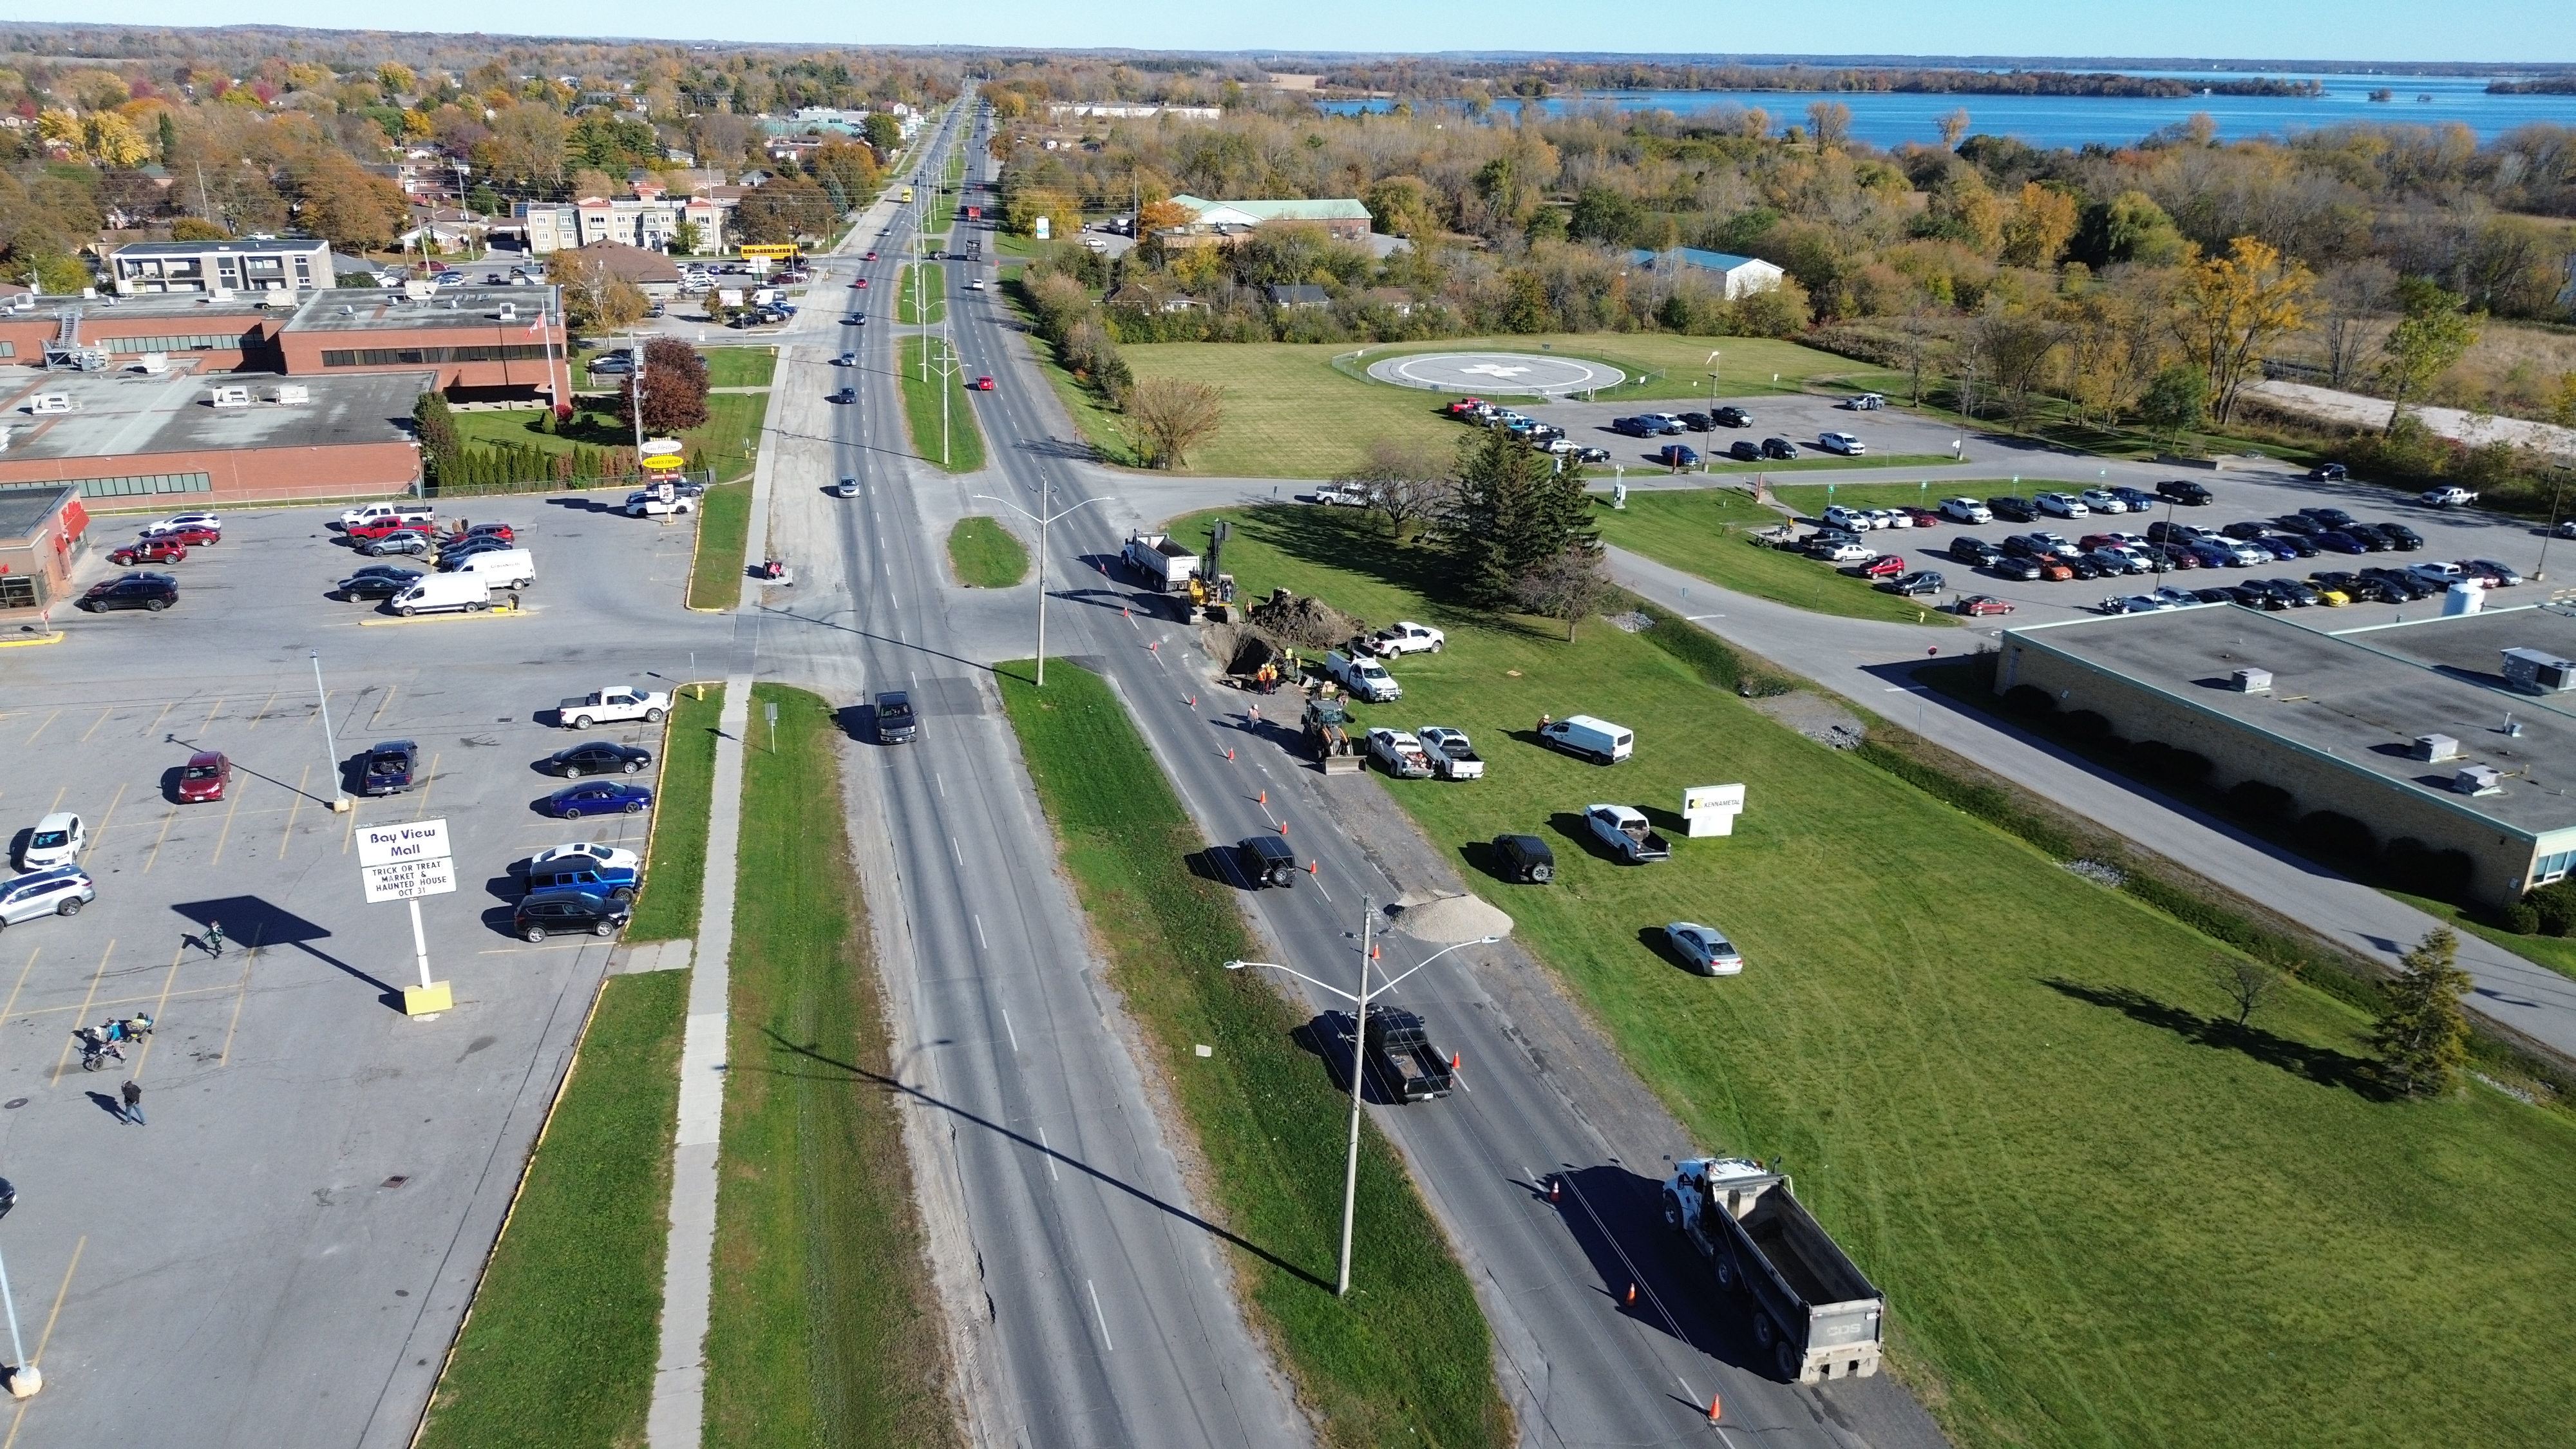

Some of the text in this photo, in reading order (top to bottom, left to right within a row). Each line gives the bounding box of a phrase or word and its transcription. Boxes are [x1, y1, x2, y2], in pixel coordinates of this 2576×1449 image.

[370, 829, 435, 843] Bay View
[391, 844, 420, 857] Mall
[372, 861, 440, 876] TRICK OR TREAT
[376, 876, 447, 892] HAUNTED HOUSE
[381, 873, 415, 882] MARKET
[398, 887, 426, 897] OCT 31
